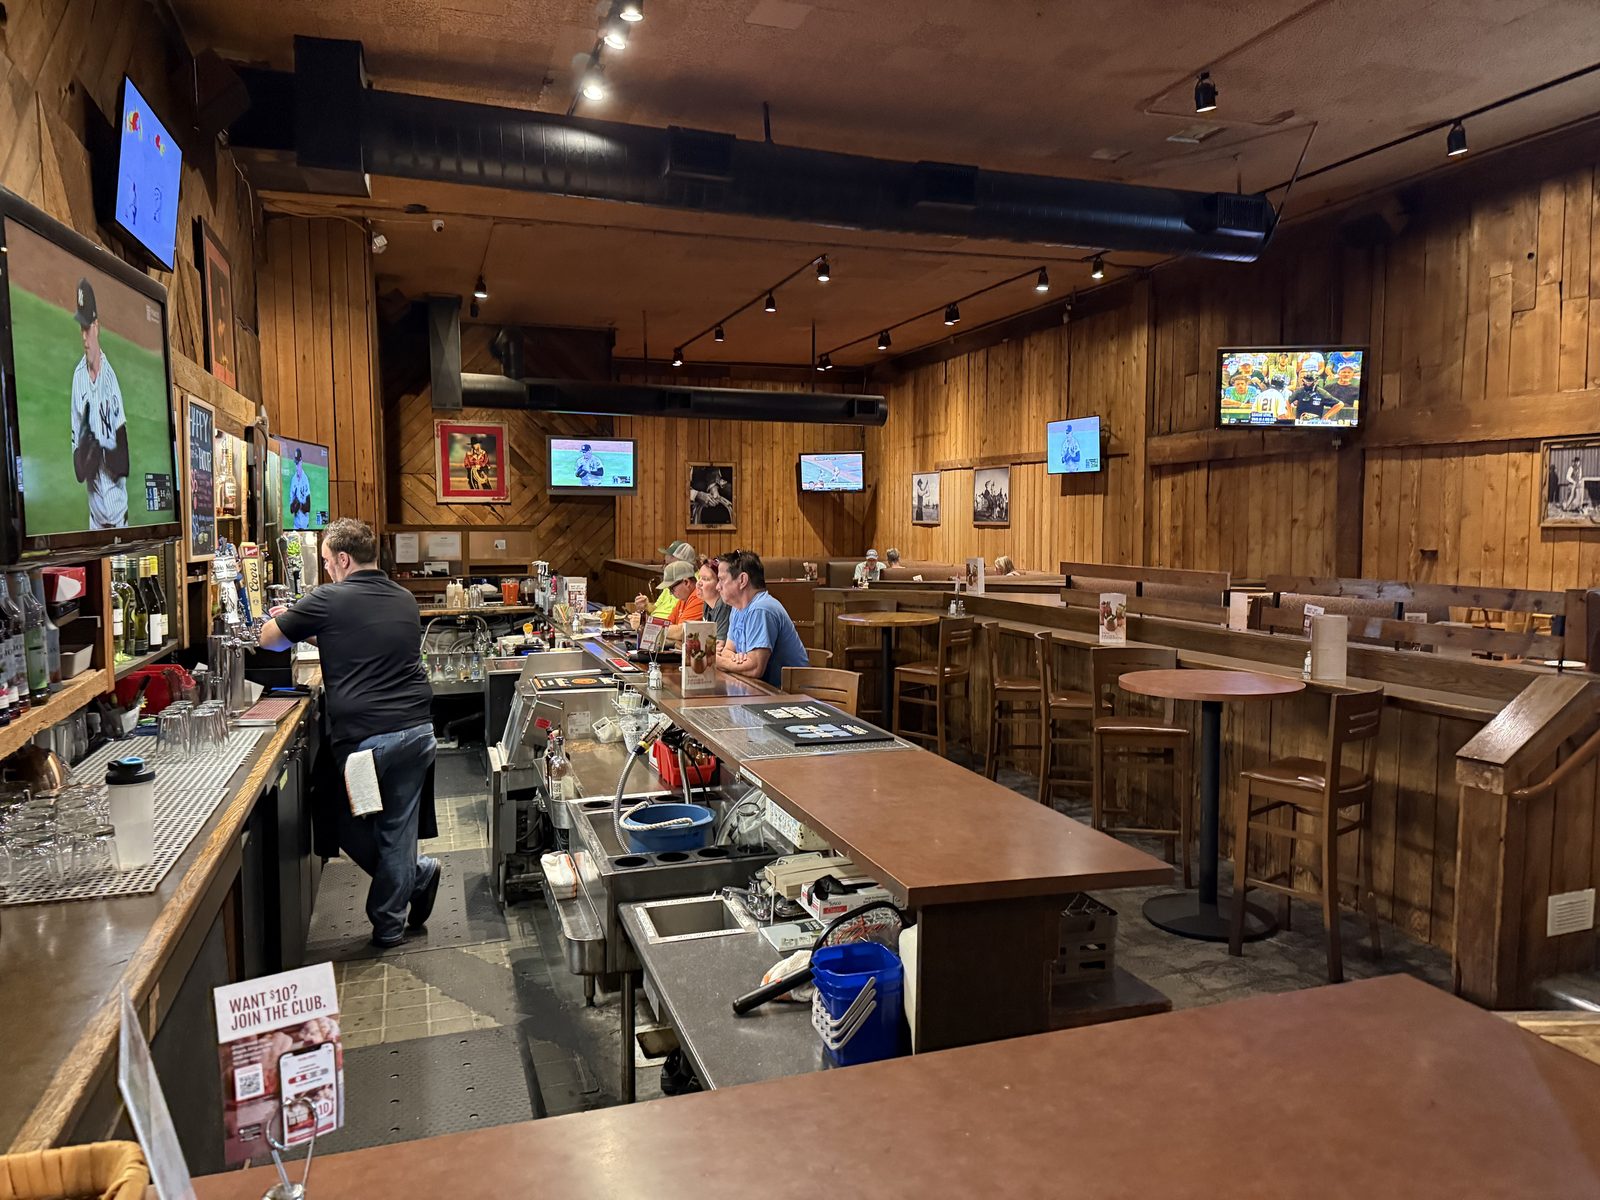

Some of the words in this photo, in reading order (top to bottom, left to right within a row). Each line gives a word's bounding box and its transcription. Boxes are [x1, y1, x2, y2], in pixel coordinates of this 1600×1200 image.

[1261, 397, 1273, 412] 21
[248, 562, 260, 593] Coors
[229, 992, 266, 1014] WANT
[270, 984, 298, 1004] $10?
[231, 1010, 261, 1031] JOIN
[265, 1003, 289, 1022] THE
[291, 995, 327, 1016] CLUB.
